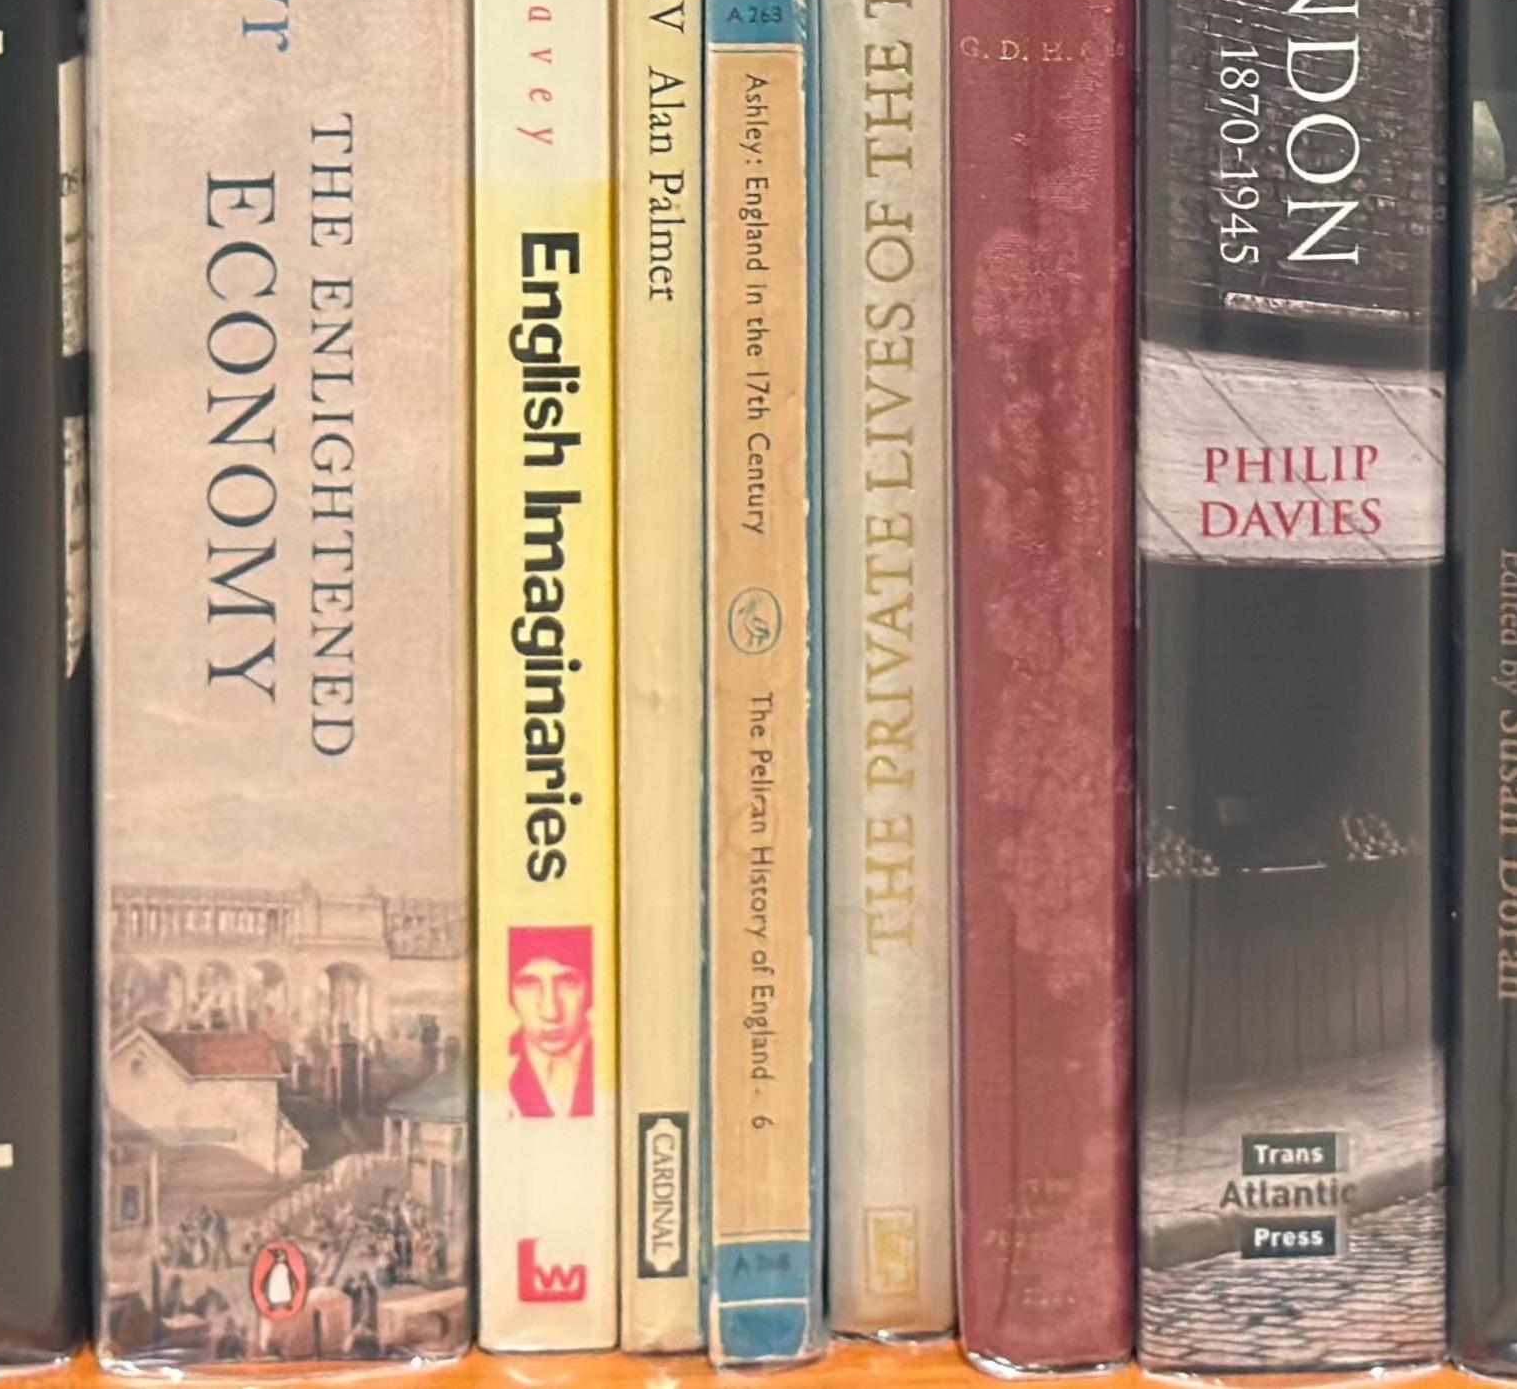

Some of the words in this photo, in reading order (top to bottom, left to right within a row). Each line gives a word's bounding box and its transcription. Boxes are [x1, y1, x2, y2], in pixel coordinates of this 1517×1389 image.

[727, 7, 743, 24] A
[999, 40, 1028, 61] D.
[648, 66, 683, 155] Alan
[742, 74, 770, 164] Ashley:
[865, 40, 913, 179] THE
[310, 113, 352, 247] THE
[1219, 45, 1259, 265] 1870-1945
[648, 170, 683, 302] Palmer
[739, 176, 769, 272] England
[866, 199, 914, 284] OF
[747, 315, 769, 358] the
[748, 284, 766, 302] in
[510, 232, 580, 468] English
[866, 297, 914, 490] LIVES
[206, 171, 278, 702] ECONOMY
[747, 370, 770, 424] 17th
[742, 432, 770, 535] Century
[1203, 445, 1380, 485] PHILIP
[310, 279, 357, 757] ENLIGHTENED
[1201, 496, 1382, 538] DAVIES
[510, 490, 592, 883] Imaginaries
[866, 513, 914, 788] PRIVATE
[749, 692, 773, 739] The
[750, 748, 772, 832] Pelican
[742, 846, 772, 943] History
[865, 811, 914, 955] THE
[751, 952, 775, 978] of
[743, 986, 776, 1079] England
[751, 1116, 767, 1130] 6
[1253, 1144, 1323, 1163] Trans
[650, 1132, 678, 1254] CARDINAL
[1220, 1179, 1356, 1208] Atlantic
[1254, 1228, 1323, 1246] Press
